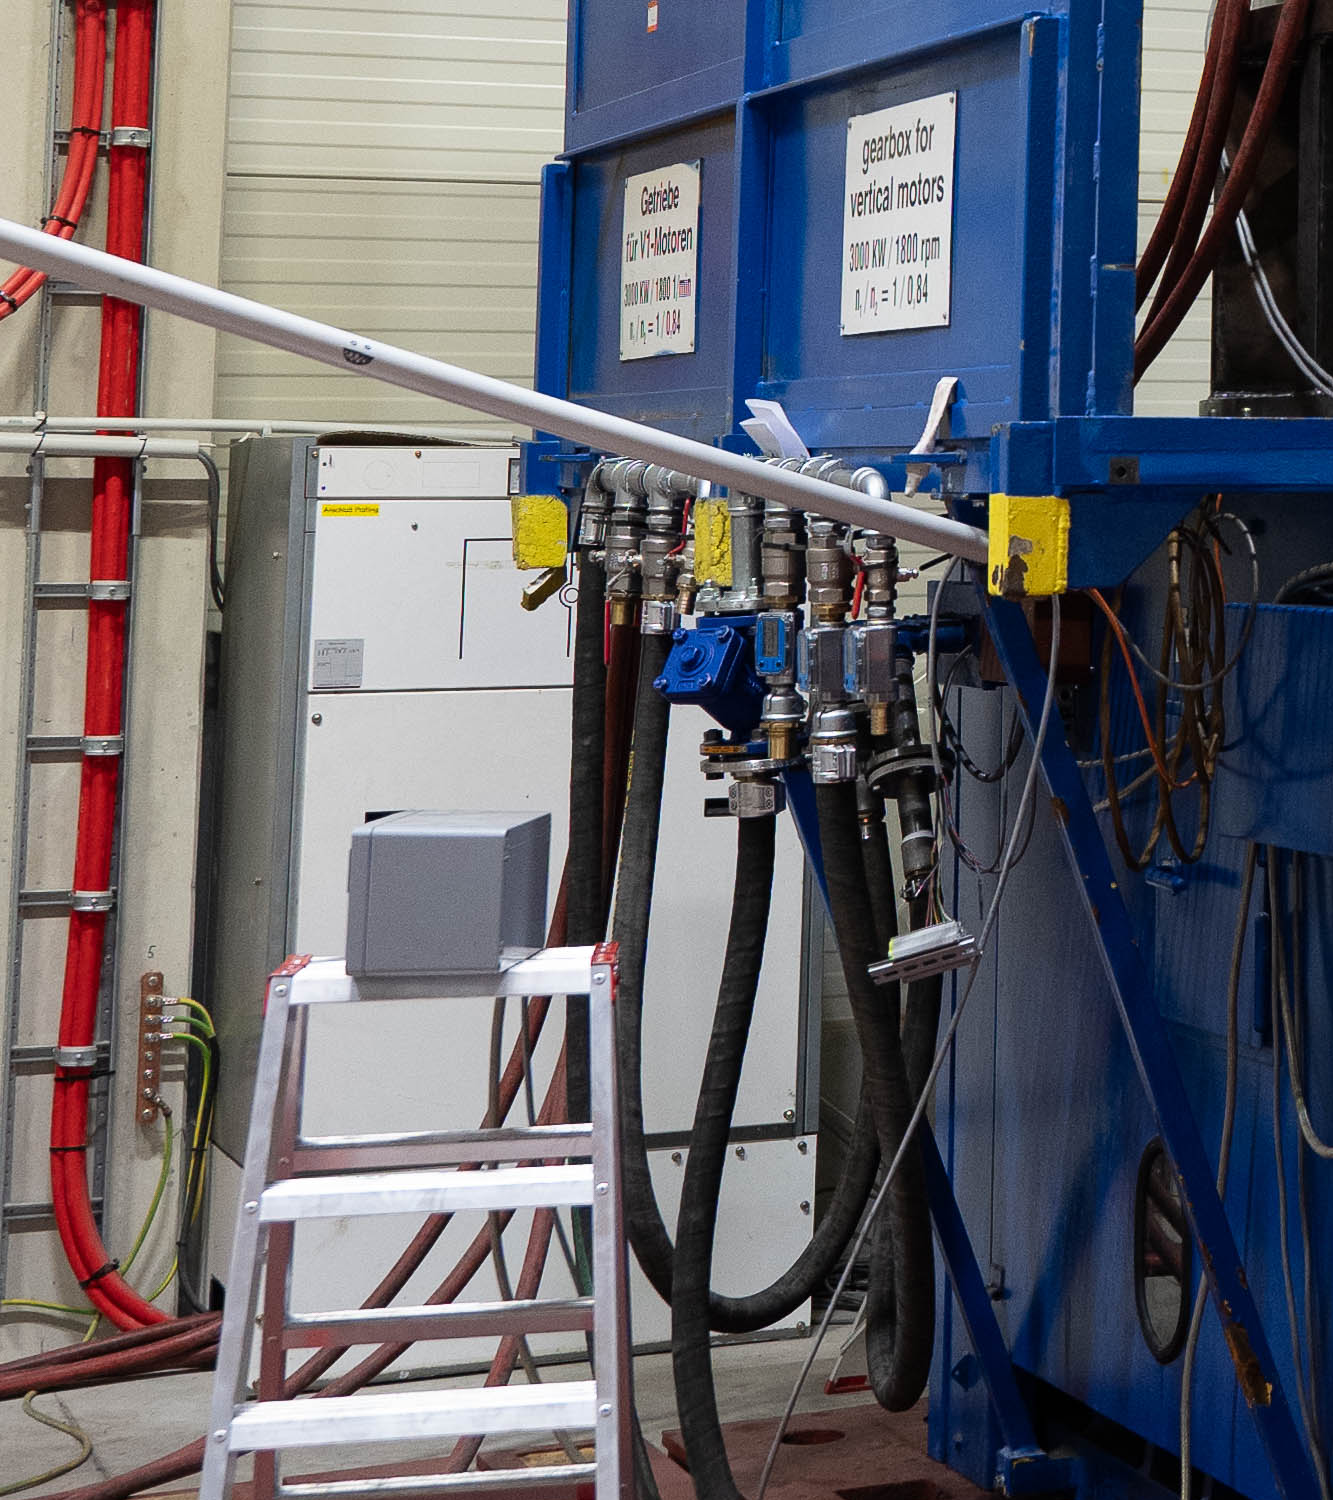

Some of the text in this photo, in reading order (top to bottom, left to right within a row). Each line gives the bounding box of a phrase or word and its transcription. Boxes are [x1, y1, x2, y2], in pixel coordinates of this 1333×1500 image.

[862, 117, 934, 174] gearbox for
[641, 181, 679, 216] Getriebe
[850, 172, 944, 218] vertical motors
[626, 226, 693, 262] für V1-Motoren
[849, 240, 869, 272] 3000
[871, 237, 886, 268] KW
[895, 232, 918, 265] 1800
[920, 235, 940, 268] rpm
[624, 281, 638, 307] 3000
[639, 279, 649, 305] KW
[655, 275, 671, 302] 1800
[907, 273, 928, 310] 0,84
